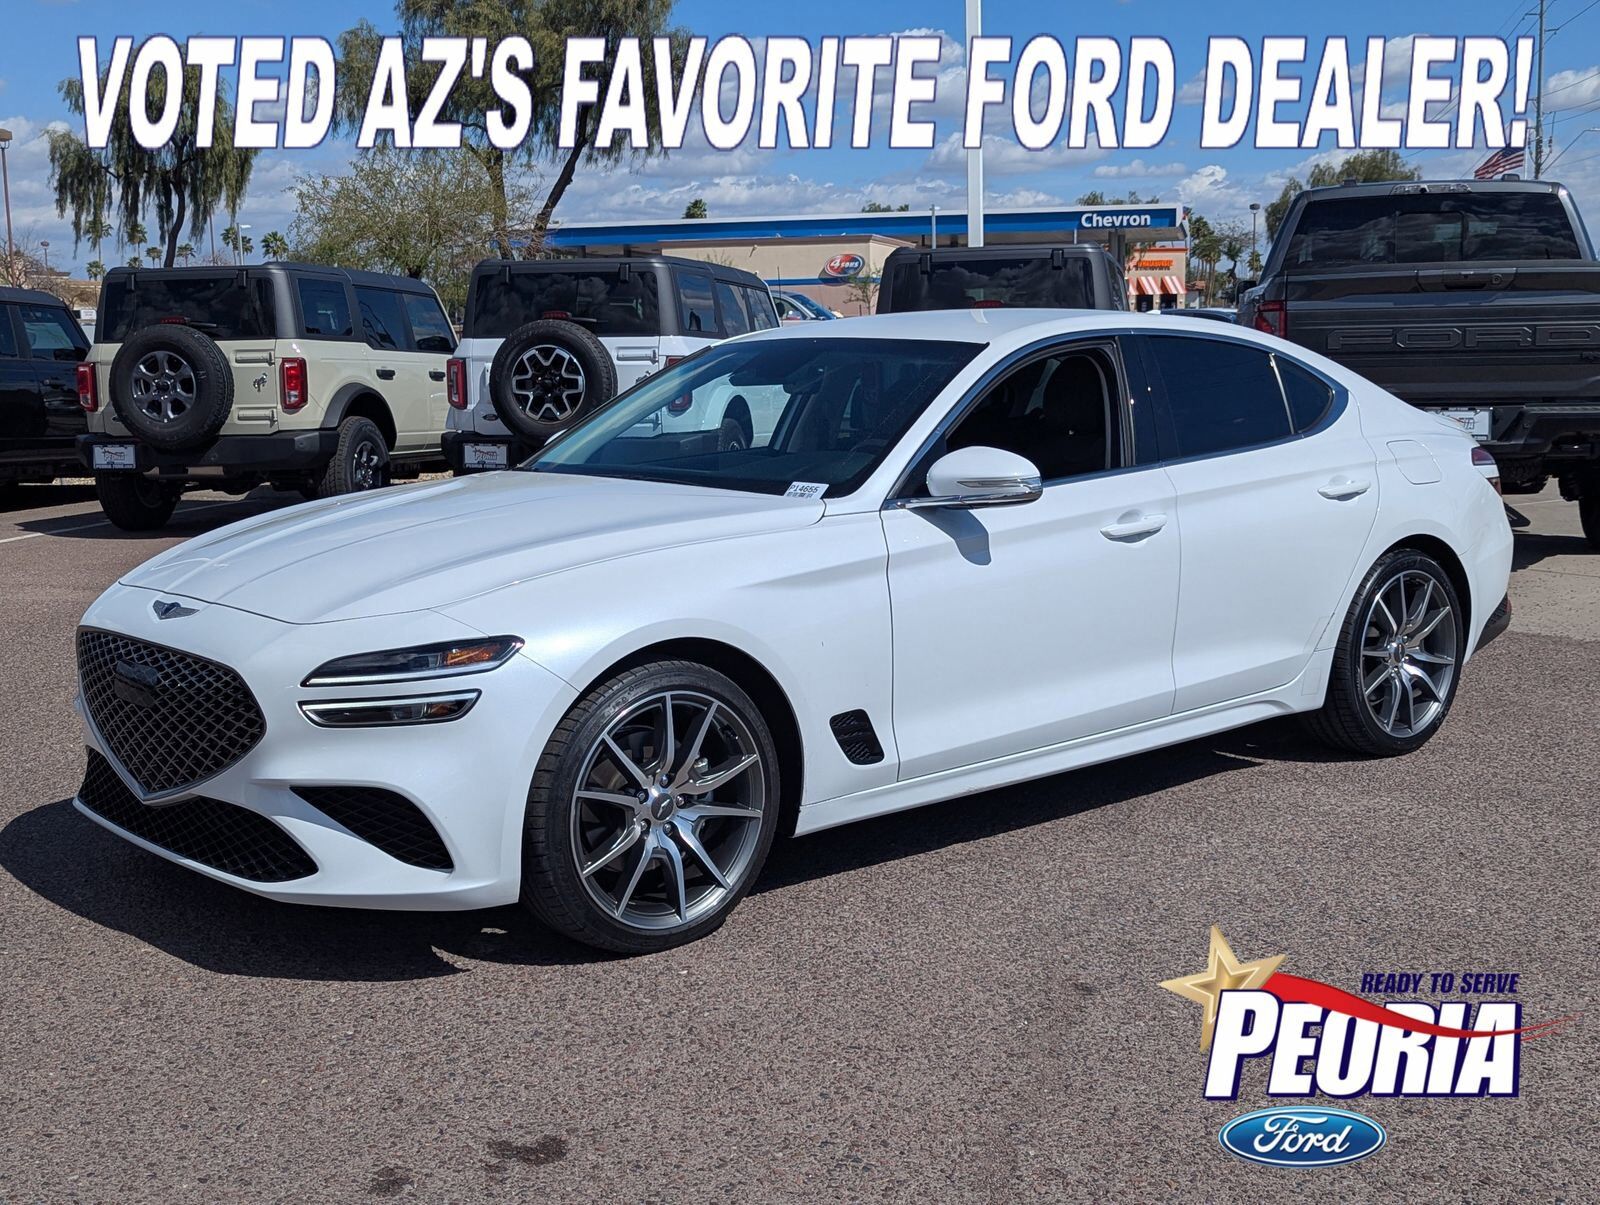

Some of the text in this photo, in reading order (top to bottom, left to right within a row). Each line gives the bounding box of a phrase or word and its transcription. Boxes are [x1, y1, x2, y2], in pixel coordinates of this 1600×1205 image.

[1081, 213, 1151, 228] Chevron
[1328, 325, 1600, 349] FORD
[790, 484, 820, 493] P14655
